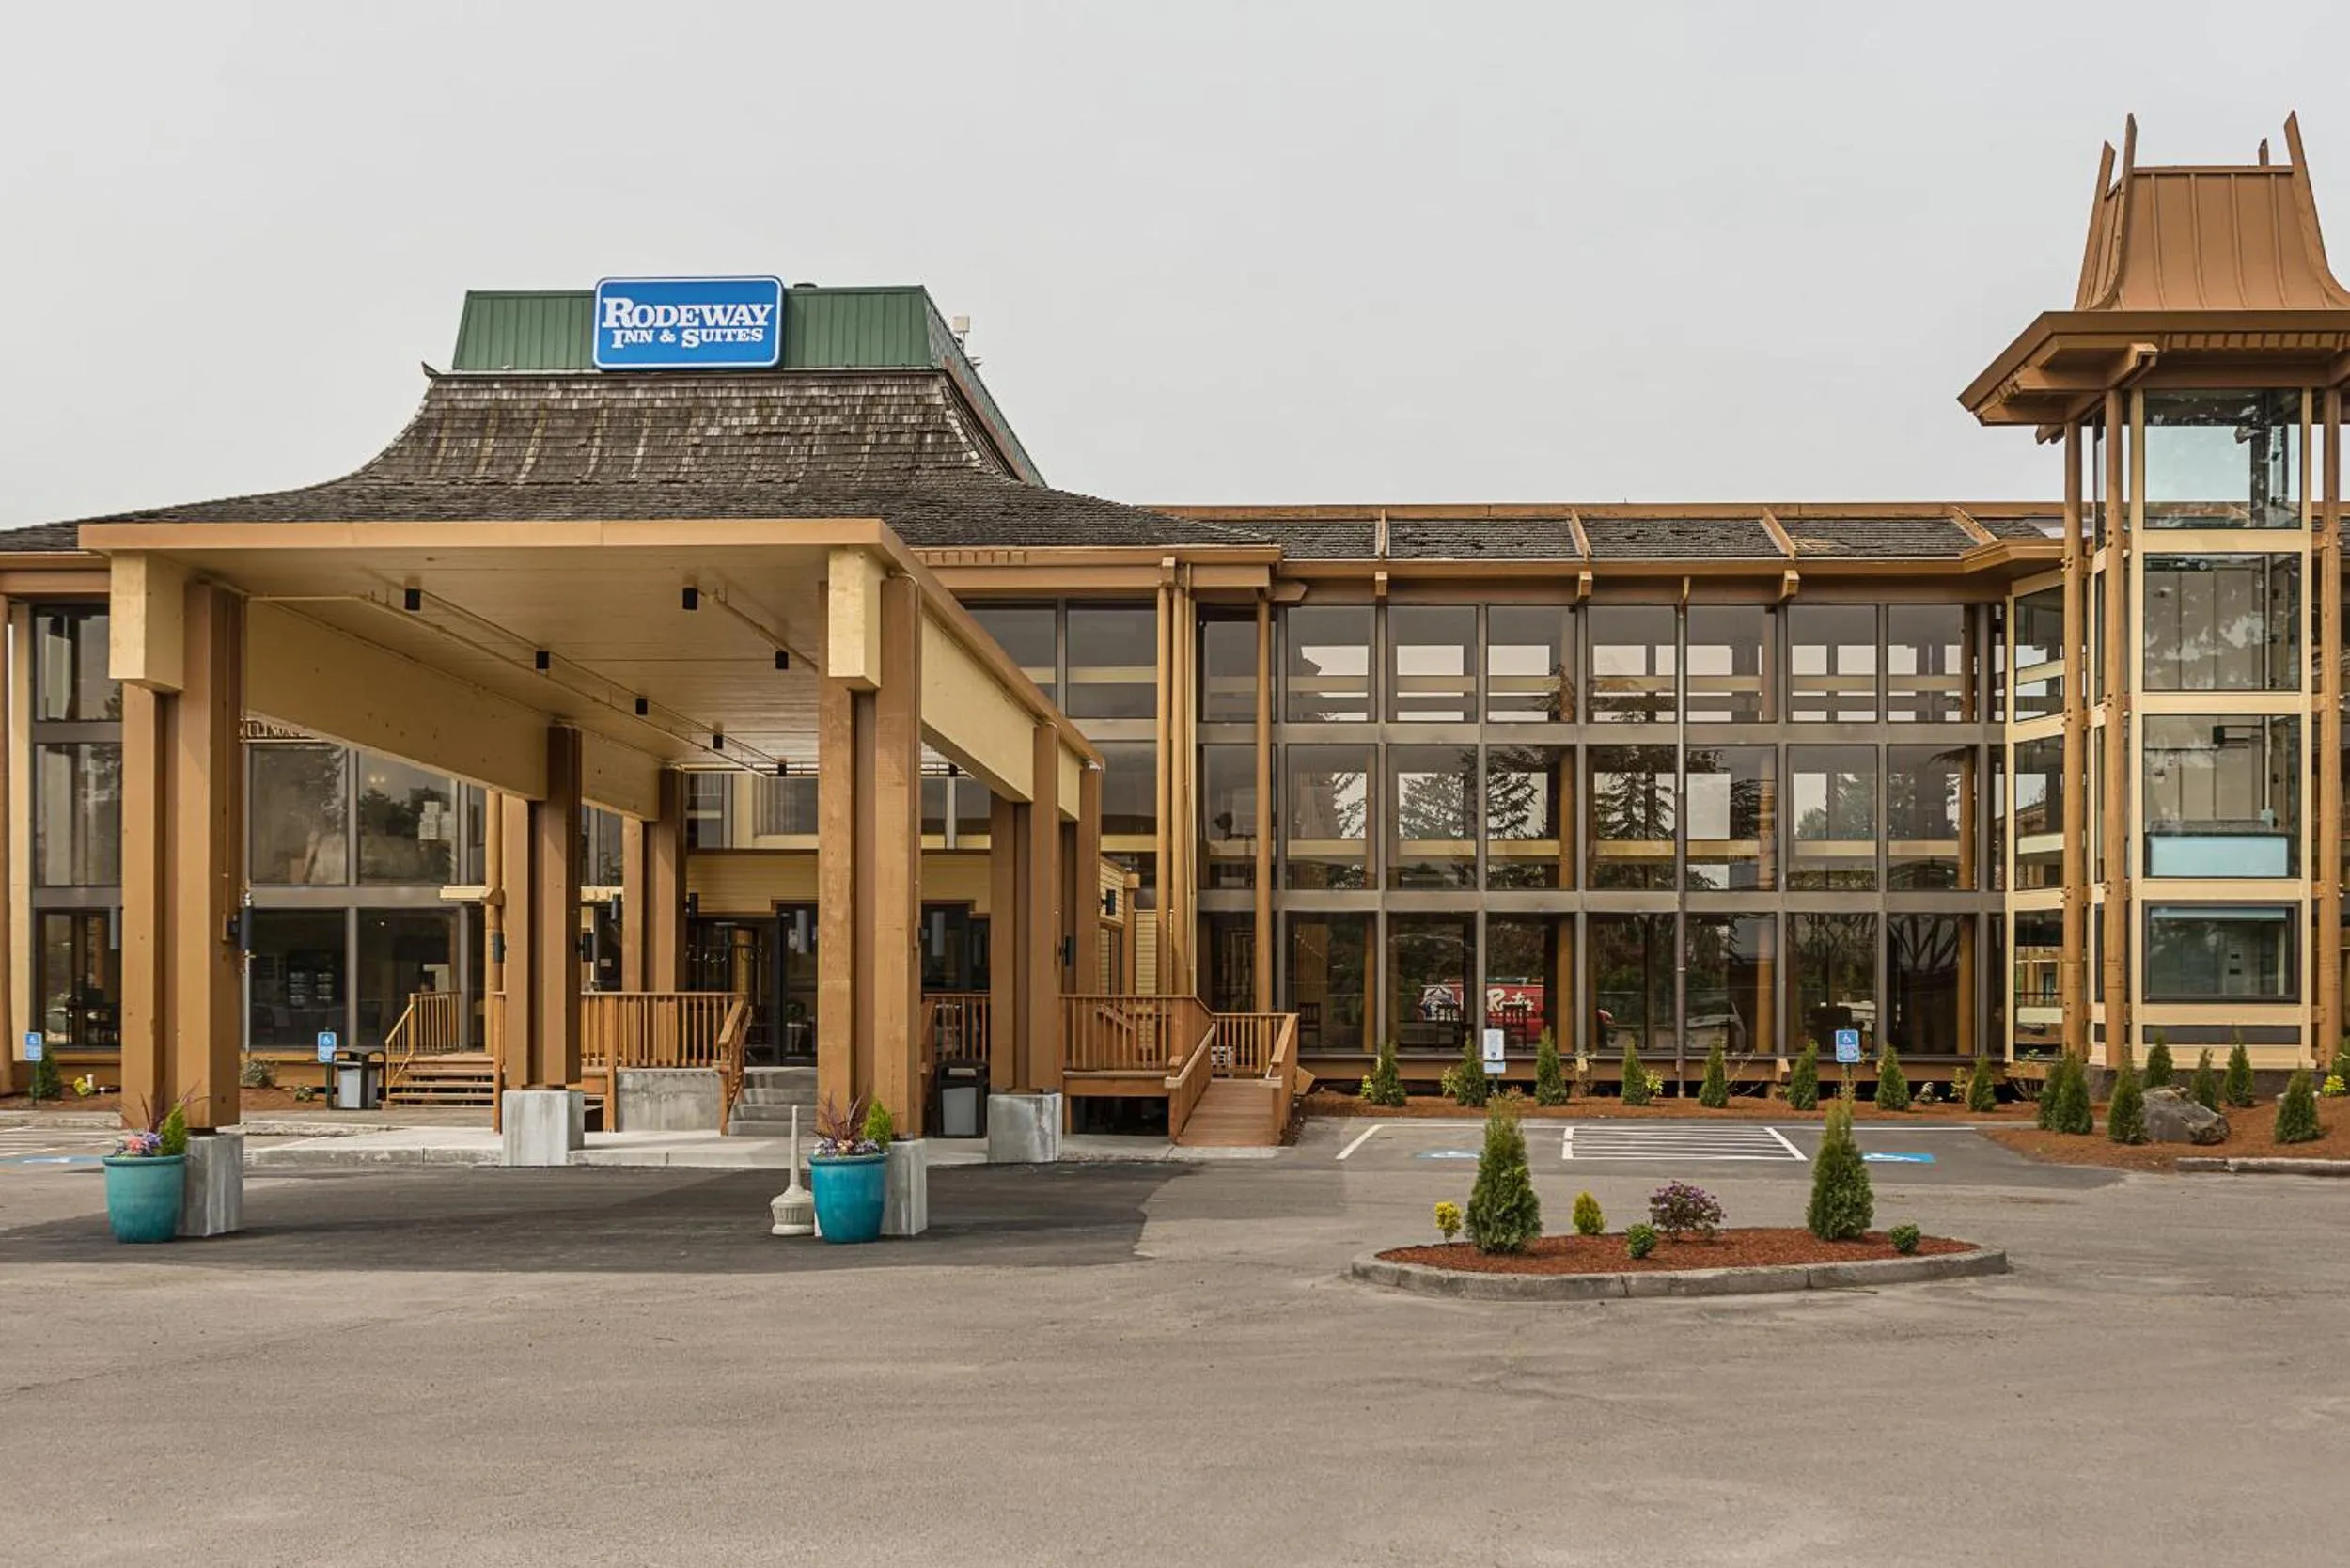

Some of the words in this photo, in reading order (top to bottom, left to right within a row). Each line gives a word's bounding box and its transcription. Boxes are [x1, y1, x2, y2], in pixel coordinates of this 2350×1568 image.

[602, 297, 775, 328] RODEWAY
[611, 329, 654, 349] INN
[660, 330, 676, 343] &
[681, 328, 764, 348] SUITES
